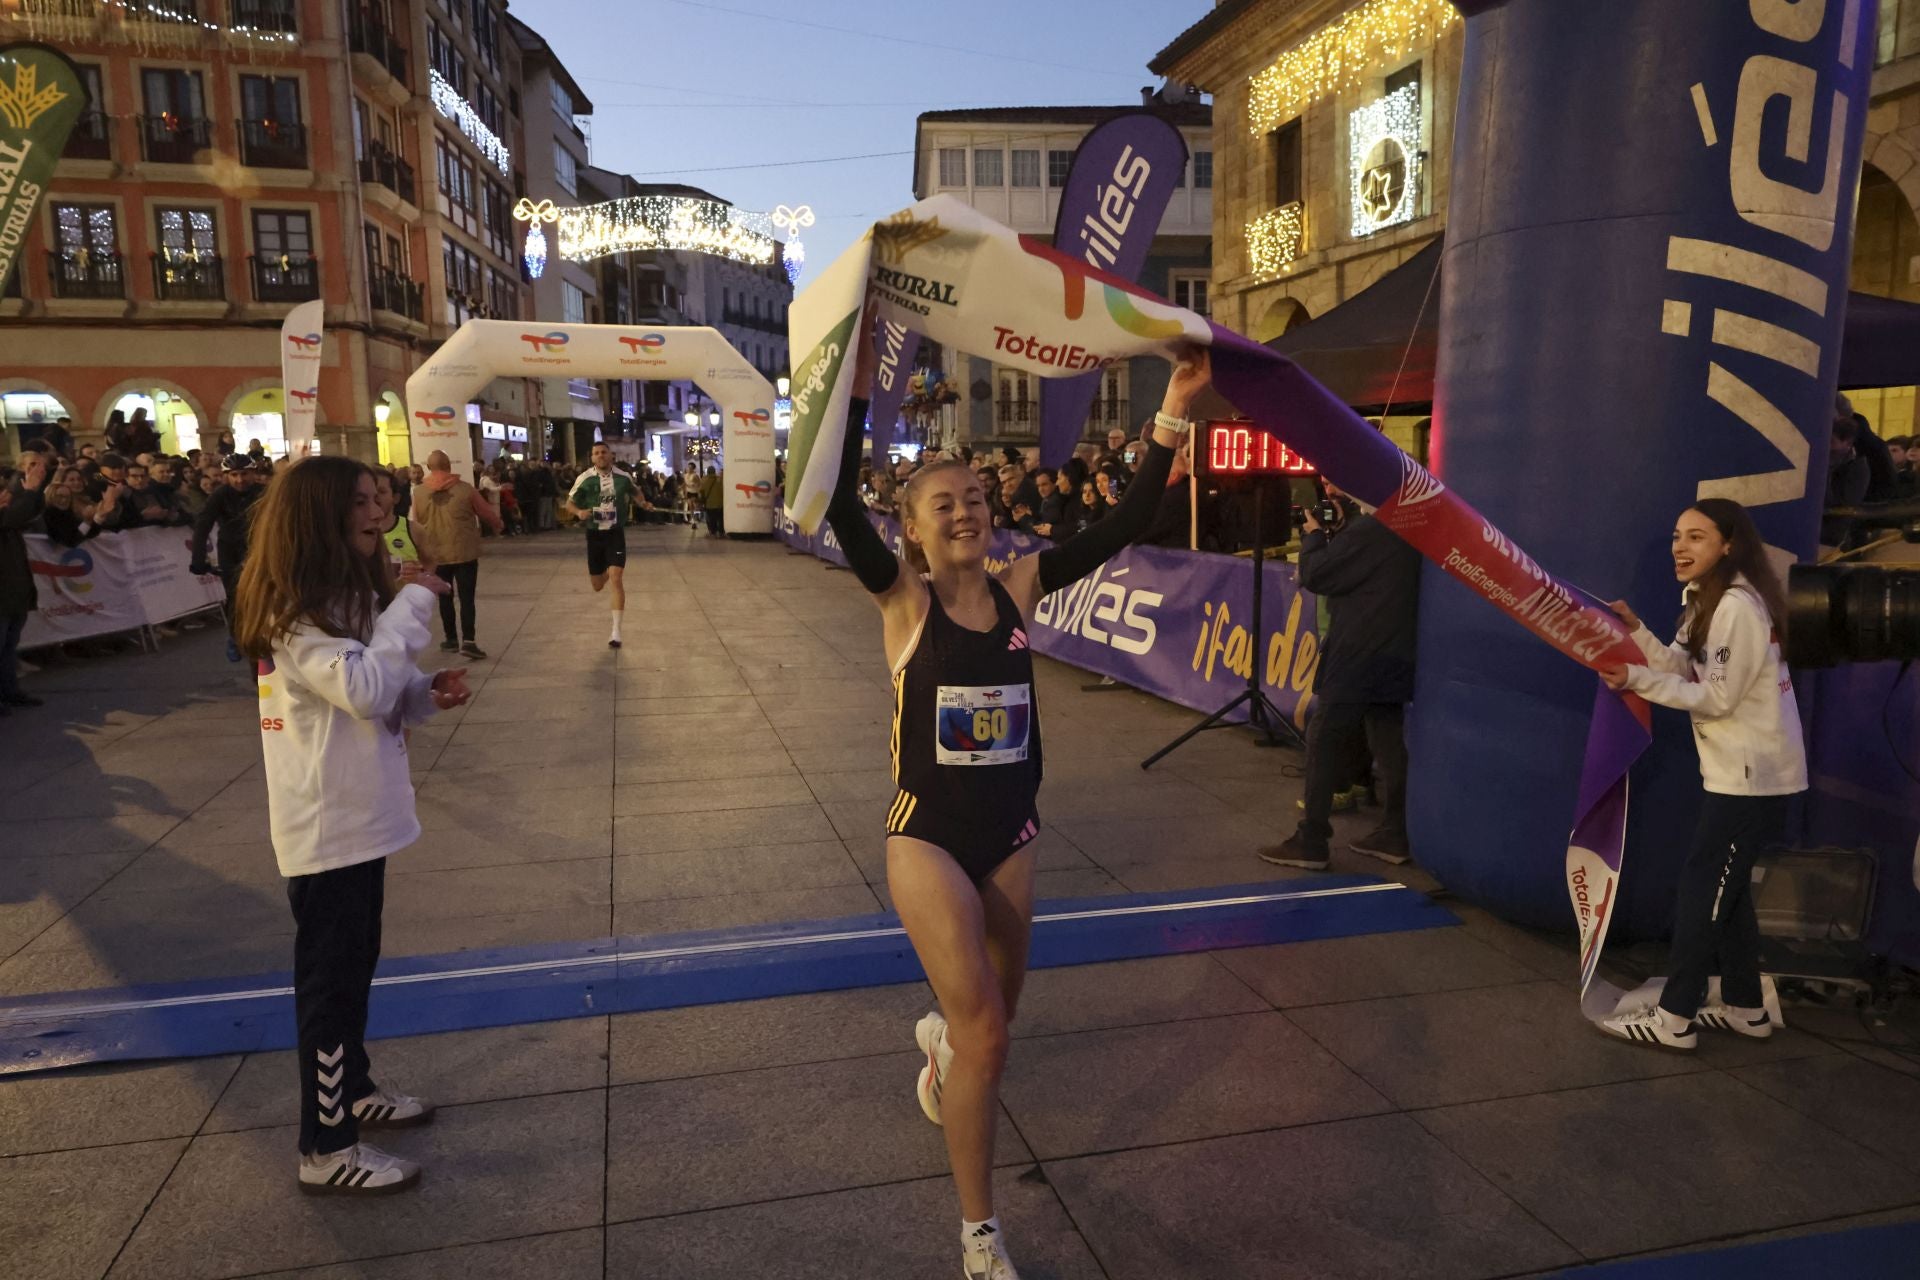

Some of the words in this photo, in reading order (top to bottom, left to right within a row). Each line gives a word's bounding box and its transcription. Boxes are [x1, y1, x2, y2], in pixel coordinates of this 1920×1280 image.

[876, 266, 958, 307] RURAL
[1444, 547, 1519, 606] TotalEnergies
[1034, 562, 1164, 655] avilés
[261, 717, 284, 731] es
[973, 708, 1008, 742] 60
